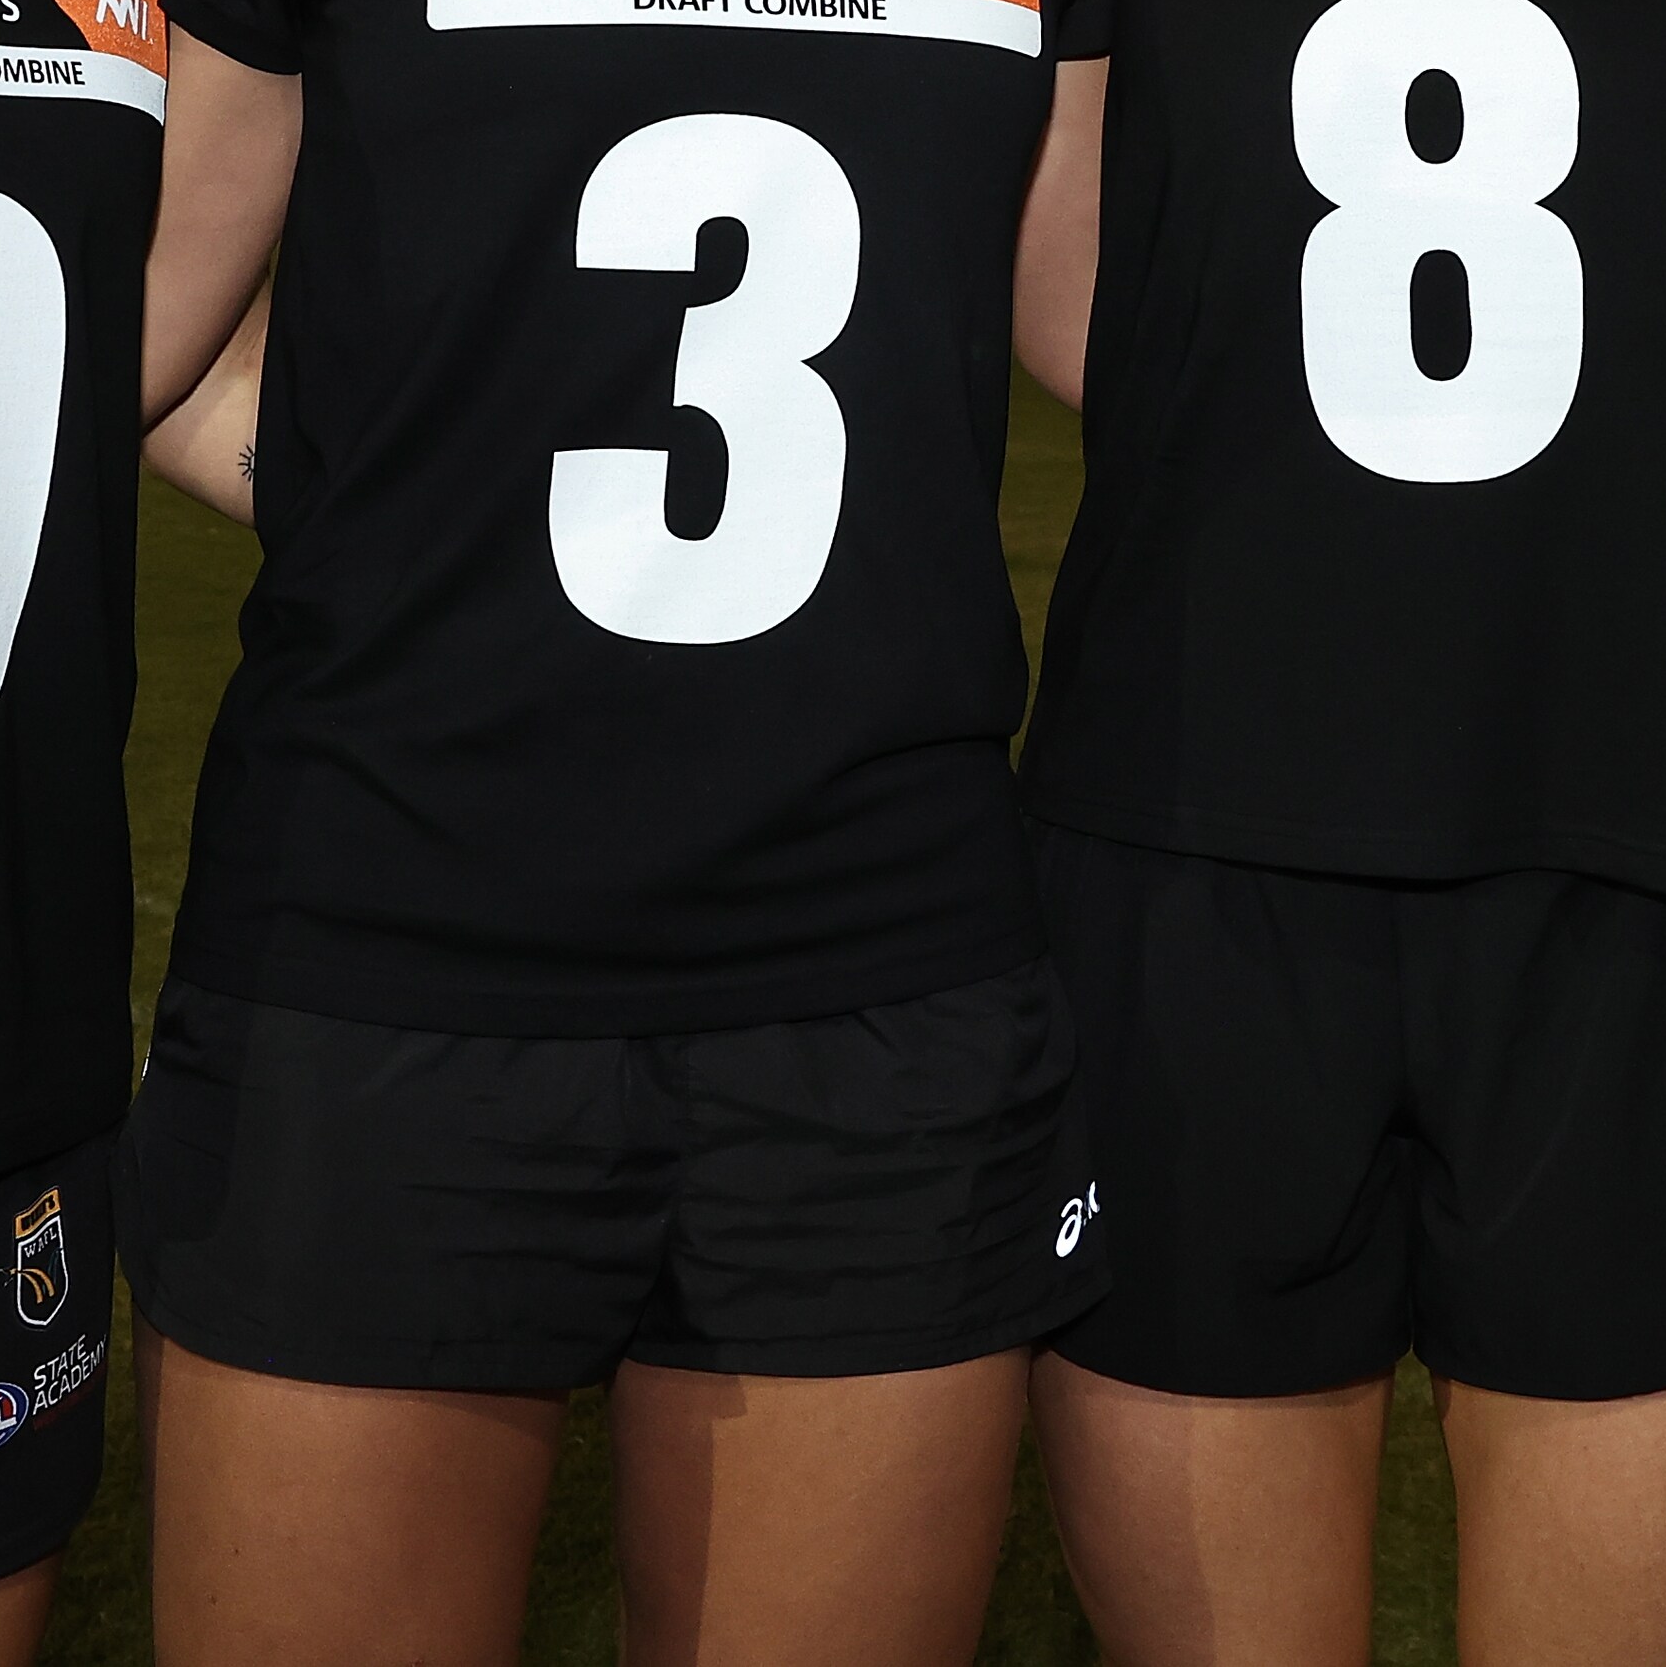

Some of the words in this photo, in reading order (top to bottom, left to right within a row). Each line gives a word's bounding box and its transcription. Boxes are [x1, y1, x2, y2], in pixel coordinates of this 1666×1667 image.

[548, 113, 861, 645] 3
[32, 1333, 108, 1416] ACADEMY
[33, 1333, 87, 1391] STATE
